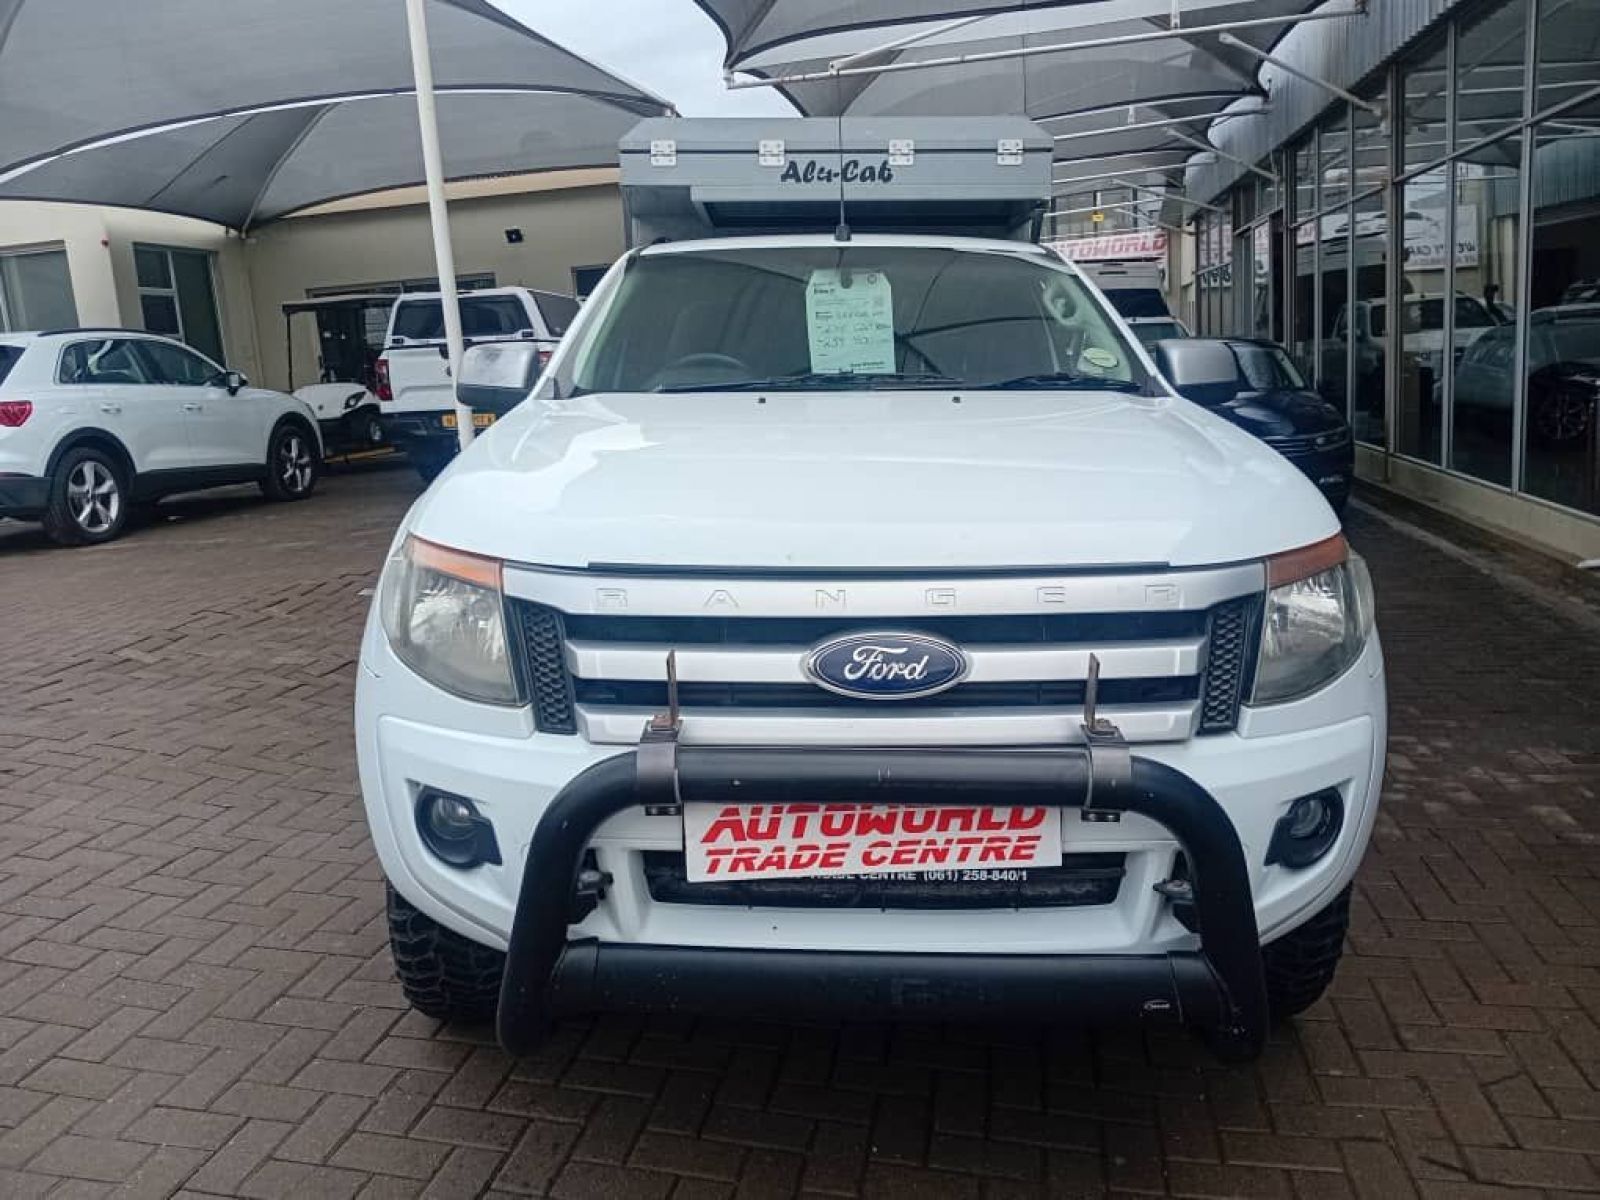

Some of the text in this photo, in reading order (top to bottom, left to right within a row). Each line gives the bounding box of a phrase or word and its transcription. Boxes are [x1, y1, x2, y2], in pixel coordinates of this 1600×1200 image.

[781, 159, 894, 184] Alu-Cab
[595, 584, 1181, 609] RANGER
[843, 645, 929, 682] Ford
[701, 803, 1046, 843] AUTOWORLD
[704, 835, 1042, 875] TRADE CENTRE
[923, 869, 958, 882] (061)
